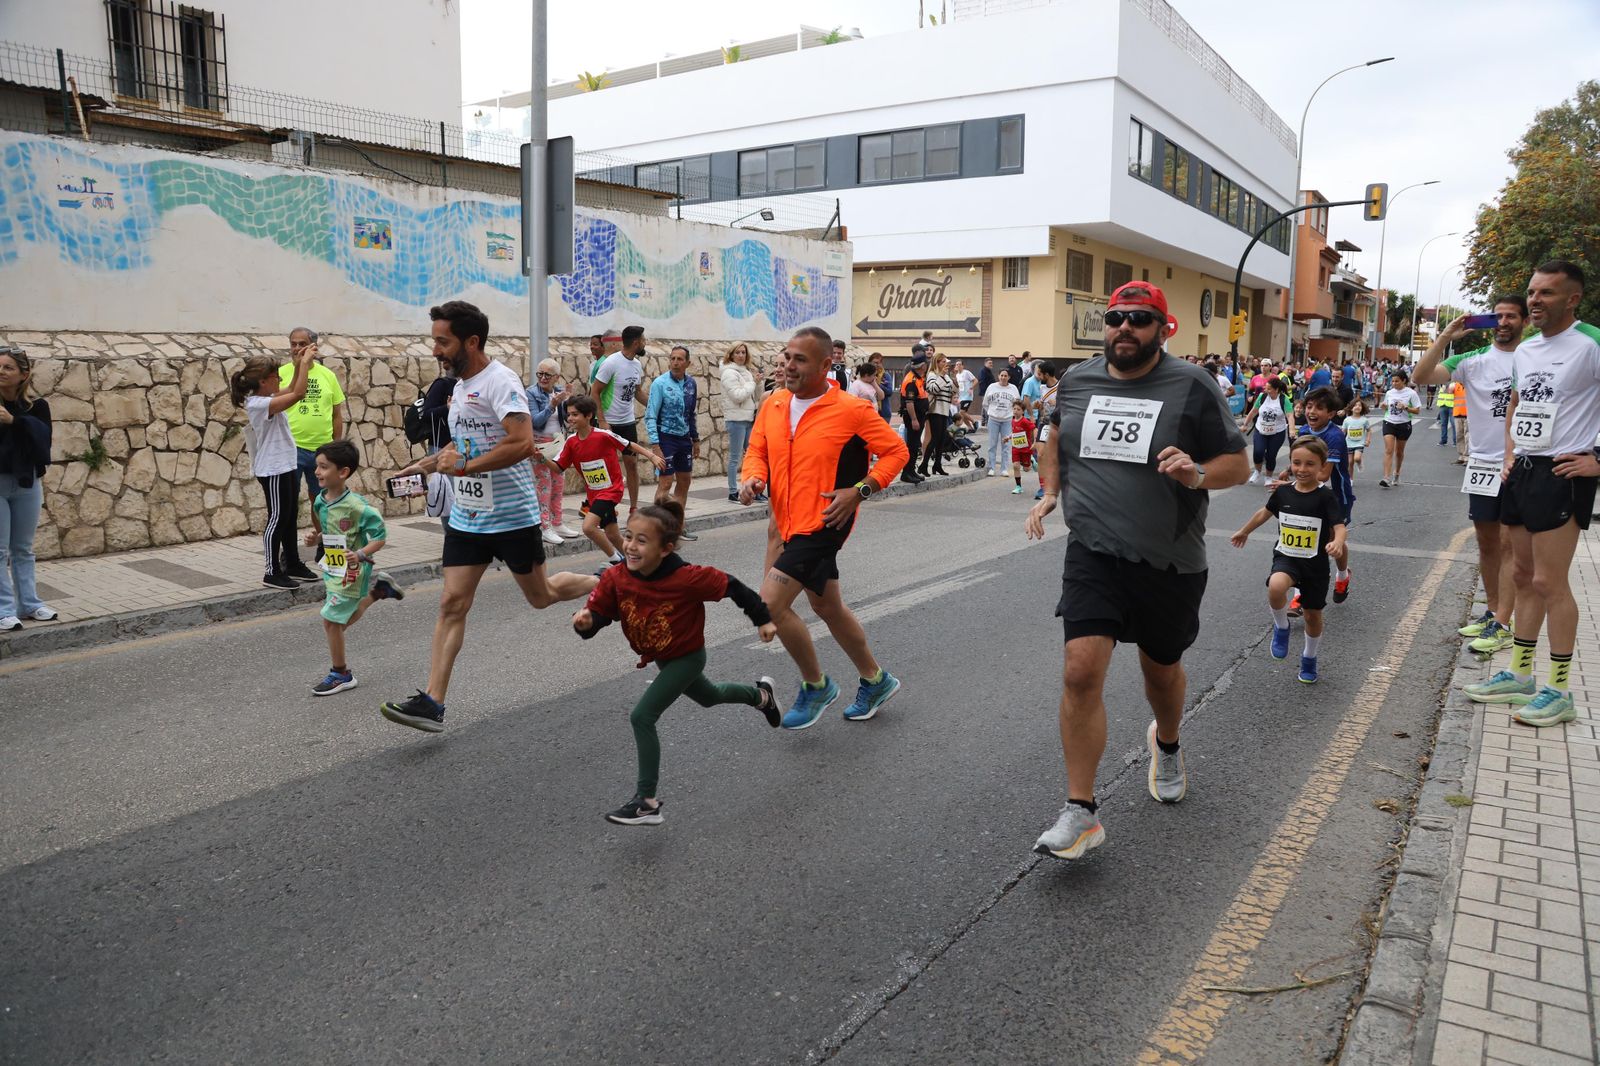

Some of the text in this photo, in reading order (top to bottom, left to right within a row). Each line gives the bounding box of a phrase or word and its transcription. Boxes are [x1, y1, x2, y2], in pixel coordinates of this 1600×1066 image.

[877, 275, 953, 318] Grand
[1097, 419, 1141, 443] 758
[1516, 420, 1543, 438] 623
[1470, 472, 1495, 486] 877
[458, 480, 484, 498] 448
[1282, 533, 1312, 548] 1011
